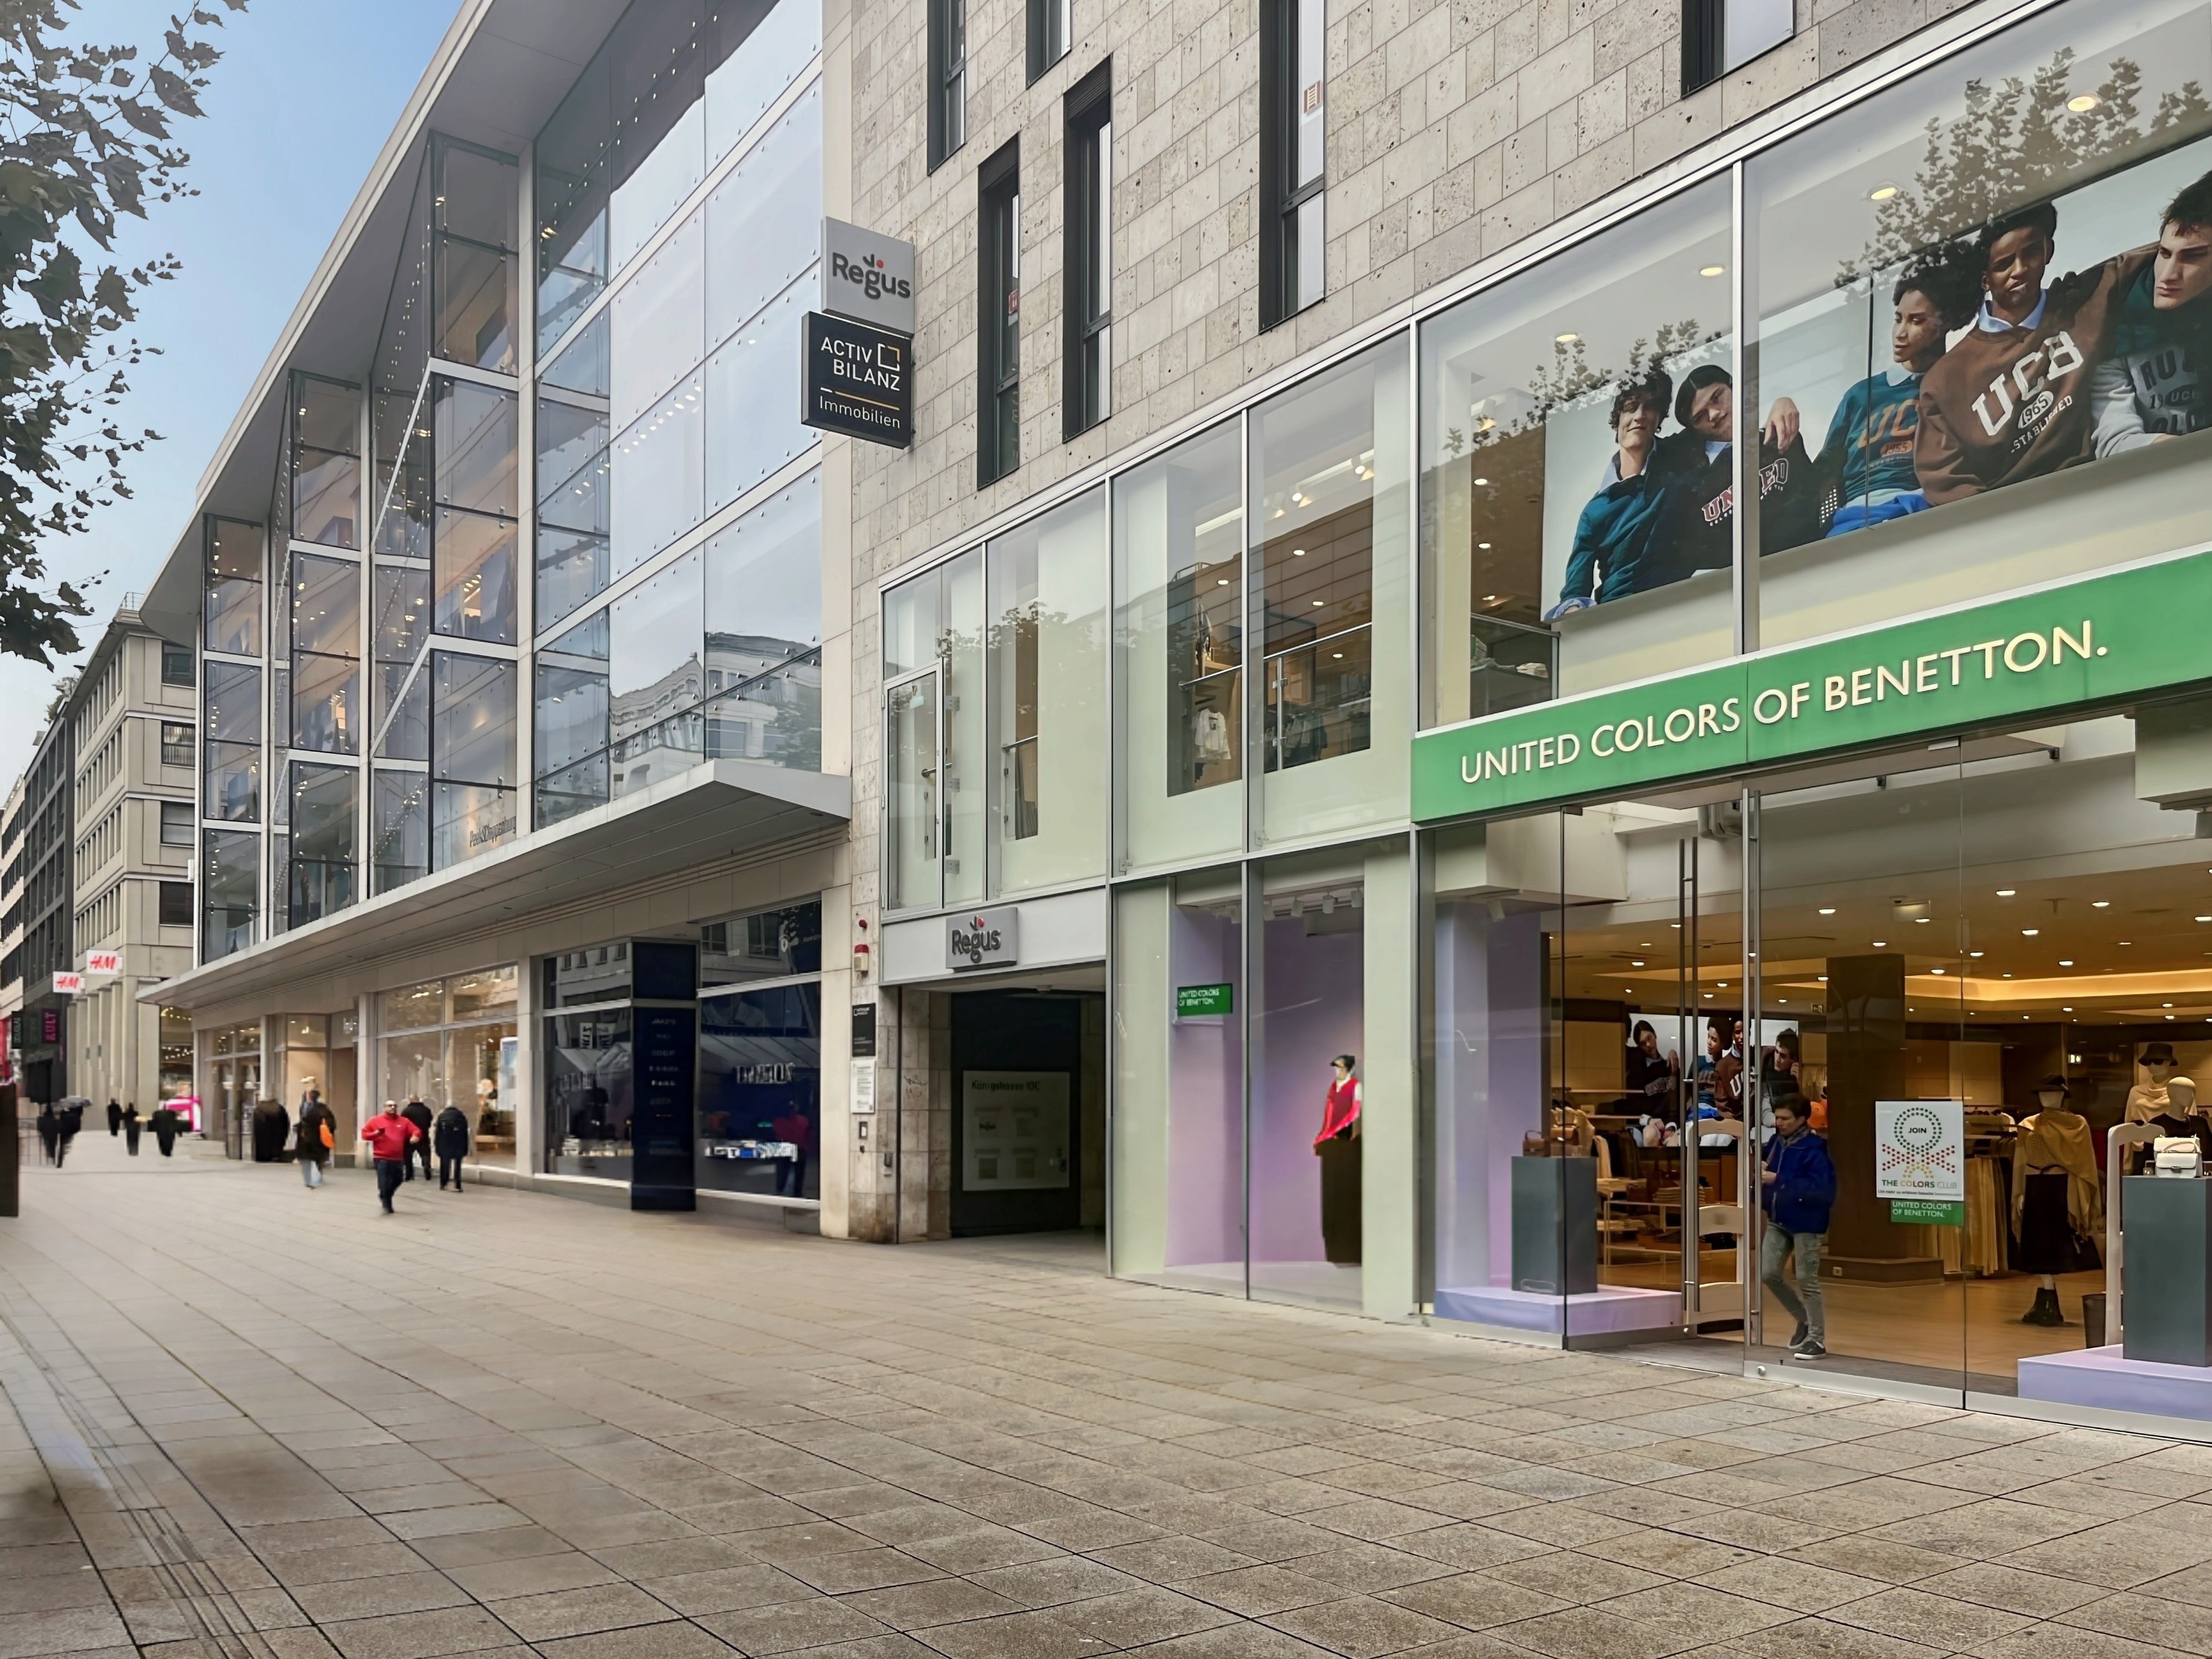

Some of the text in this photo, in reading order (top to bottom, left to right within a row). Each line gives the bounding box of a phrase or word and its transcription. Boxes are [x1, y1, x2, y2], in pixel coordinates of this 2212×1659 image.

[832, 252, 911, 300] Regus
[820, 337, 873, 363] ACTIV
[833, 359, 900, 391] BILANZ
[1971, 330, 2084, 436] UCB
[819, 395, 900, 429] Immobilien
[2011, 395, 2072, 453] STABLISHED
[2021, 394, 2048, 426] 1965
[1701, 458, 1789, 522] UNED
[1461, 620, 2107, 783] UNITED COLORS OF BENETTON.
[952, 928, 1001, 964] Regus
[1179, 988, 1220, 998] UNITED COLORS
[1900, 1180, 1935, 1188] COLORS
[1904, 1209, 1945, 1218] BENETTON.
